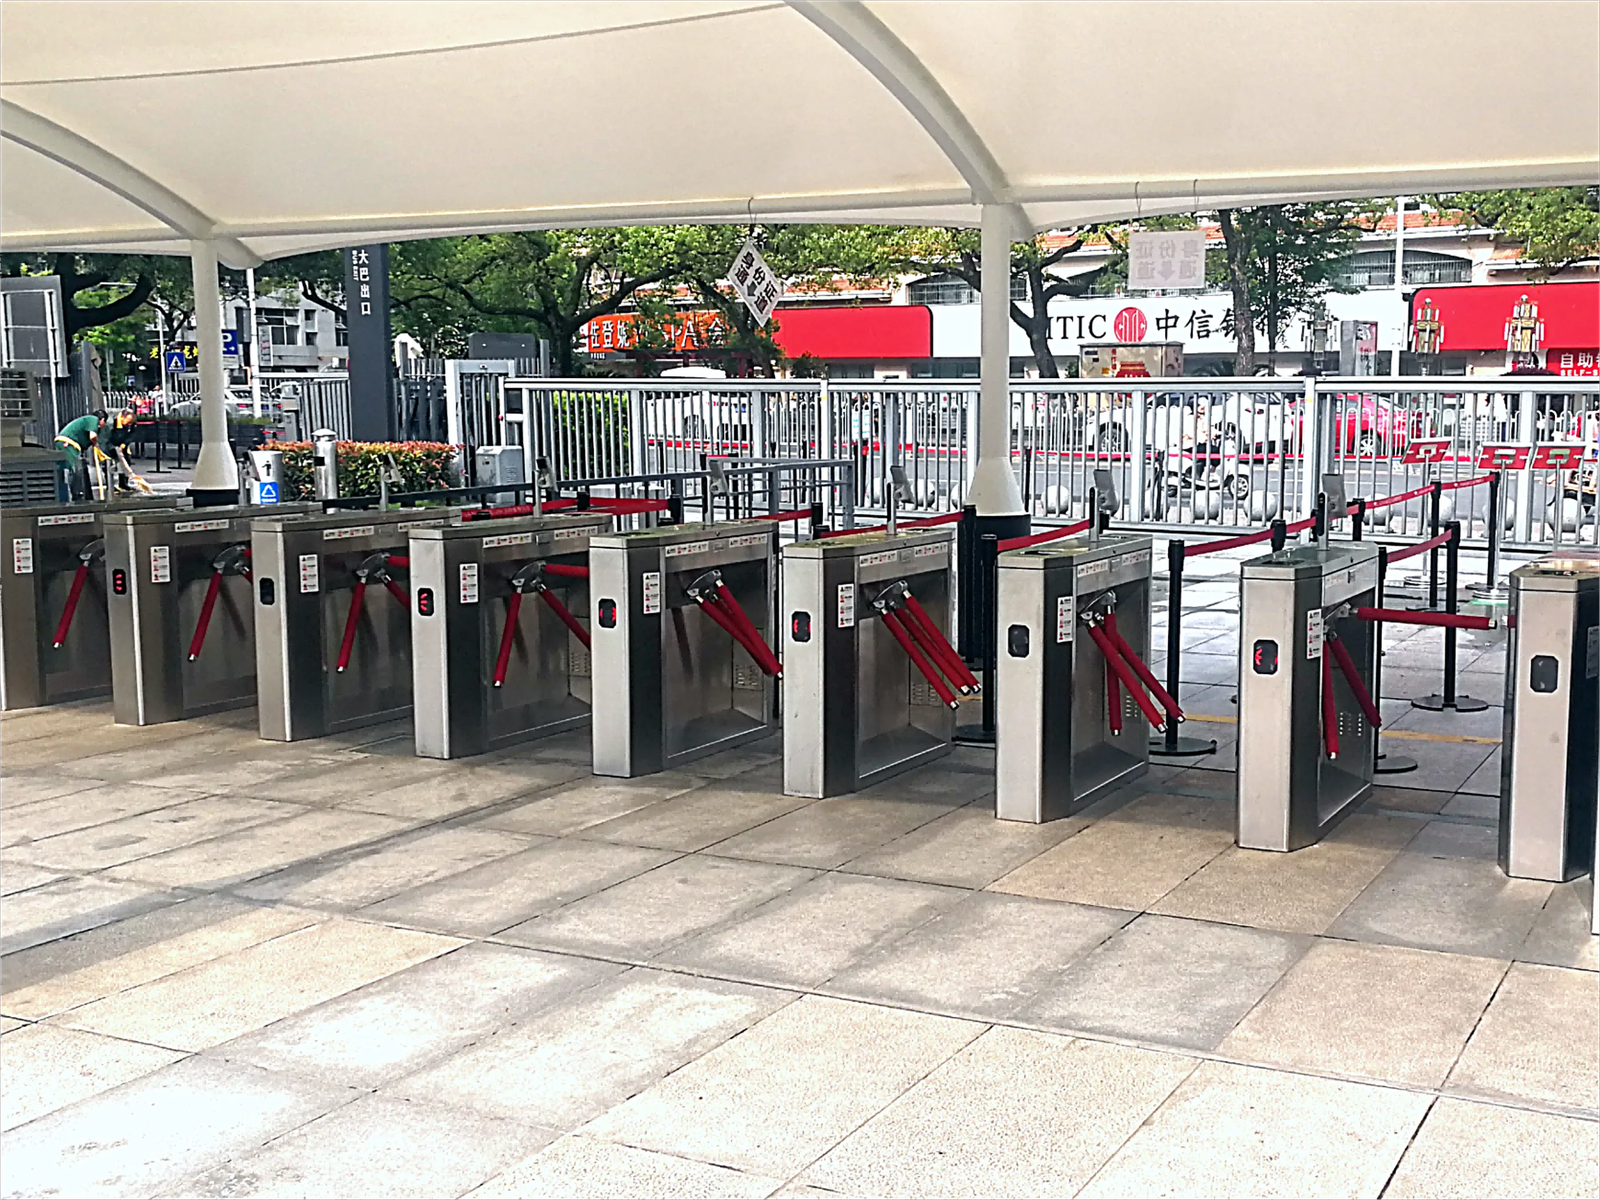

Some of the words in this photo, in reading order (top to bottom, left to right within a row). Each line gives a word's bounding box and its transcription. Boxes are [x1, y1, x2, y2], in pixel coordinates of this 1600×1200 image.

[358, 249, 372, 316] 大巴出口
[741, 251, 778, 303] 身份证
[1045, 314, 1107, 339] ITIC
[1560, 353, 1599, 369] 自助
